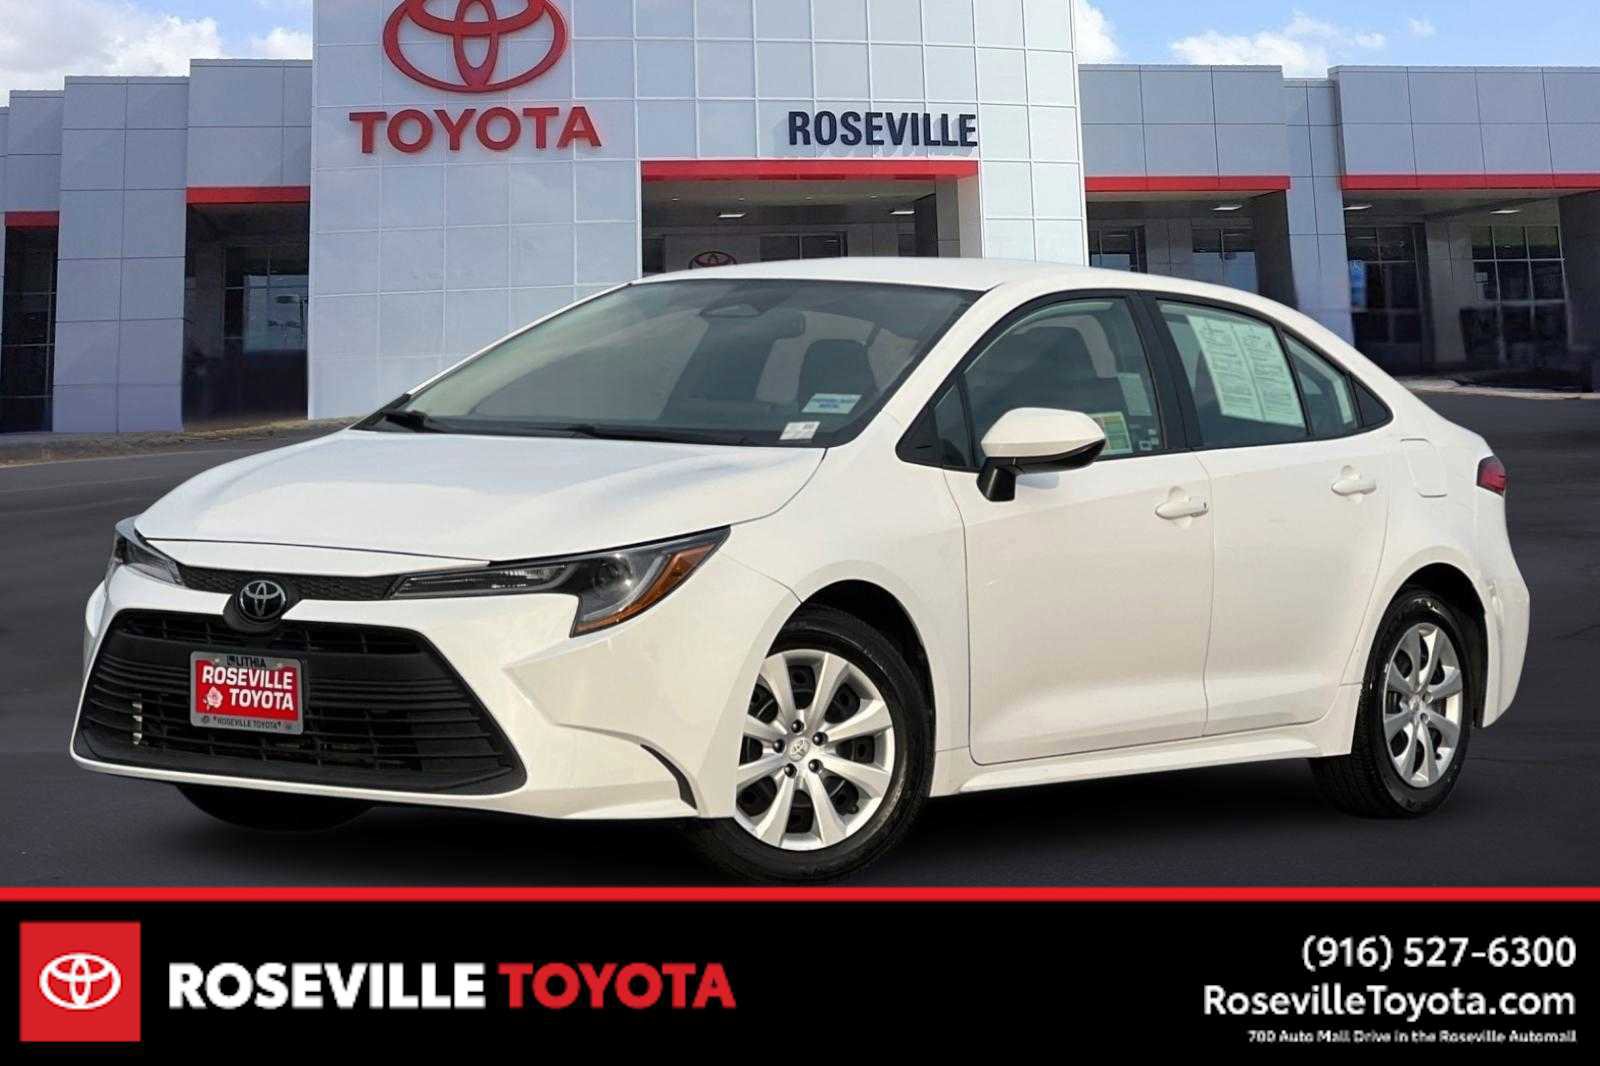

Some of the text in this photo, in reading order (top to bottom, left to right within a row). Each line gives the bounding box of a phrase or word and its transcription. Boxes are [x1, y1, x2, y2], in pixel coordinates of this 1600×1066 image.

[350, 106, 602, 153] TOYOTA
[789, 111, 978, 146] ROSEVILLE
[236, 656, 267, 668] LITHIA
[202, 666, 293, 690] ROSEVILLE
[229, 688, 295, 711] TOYOTA
